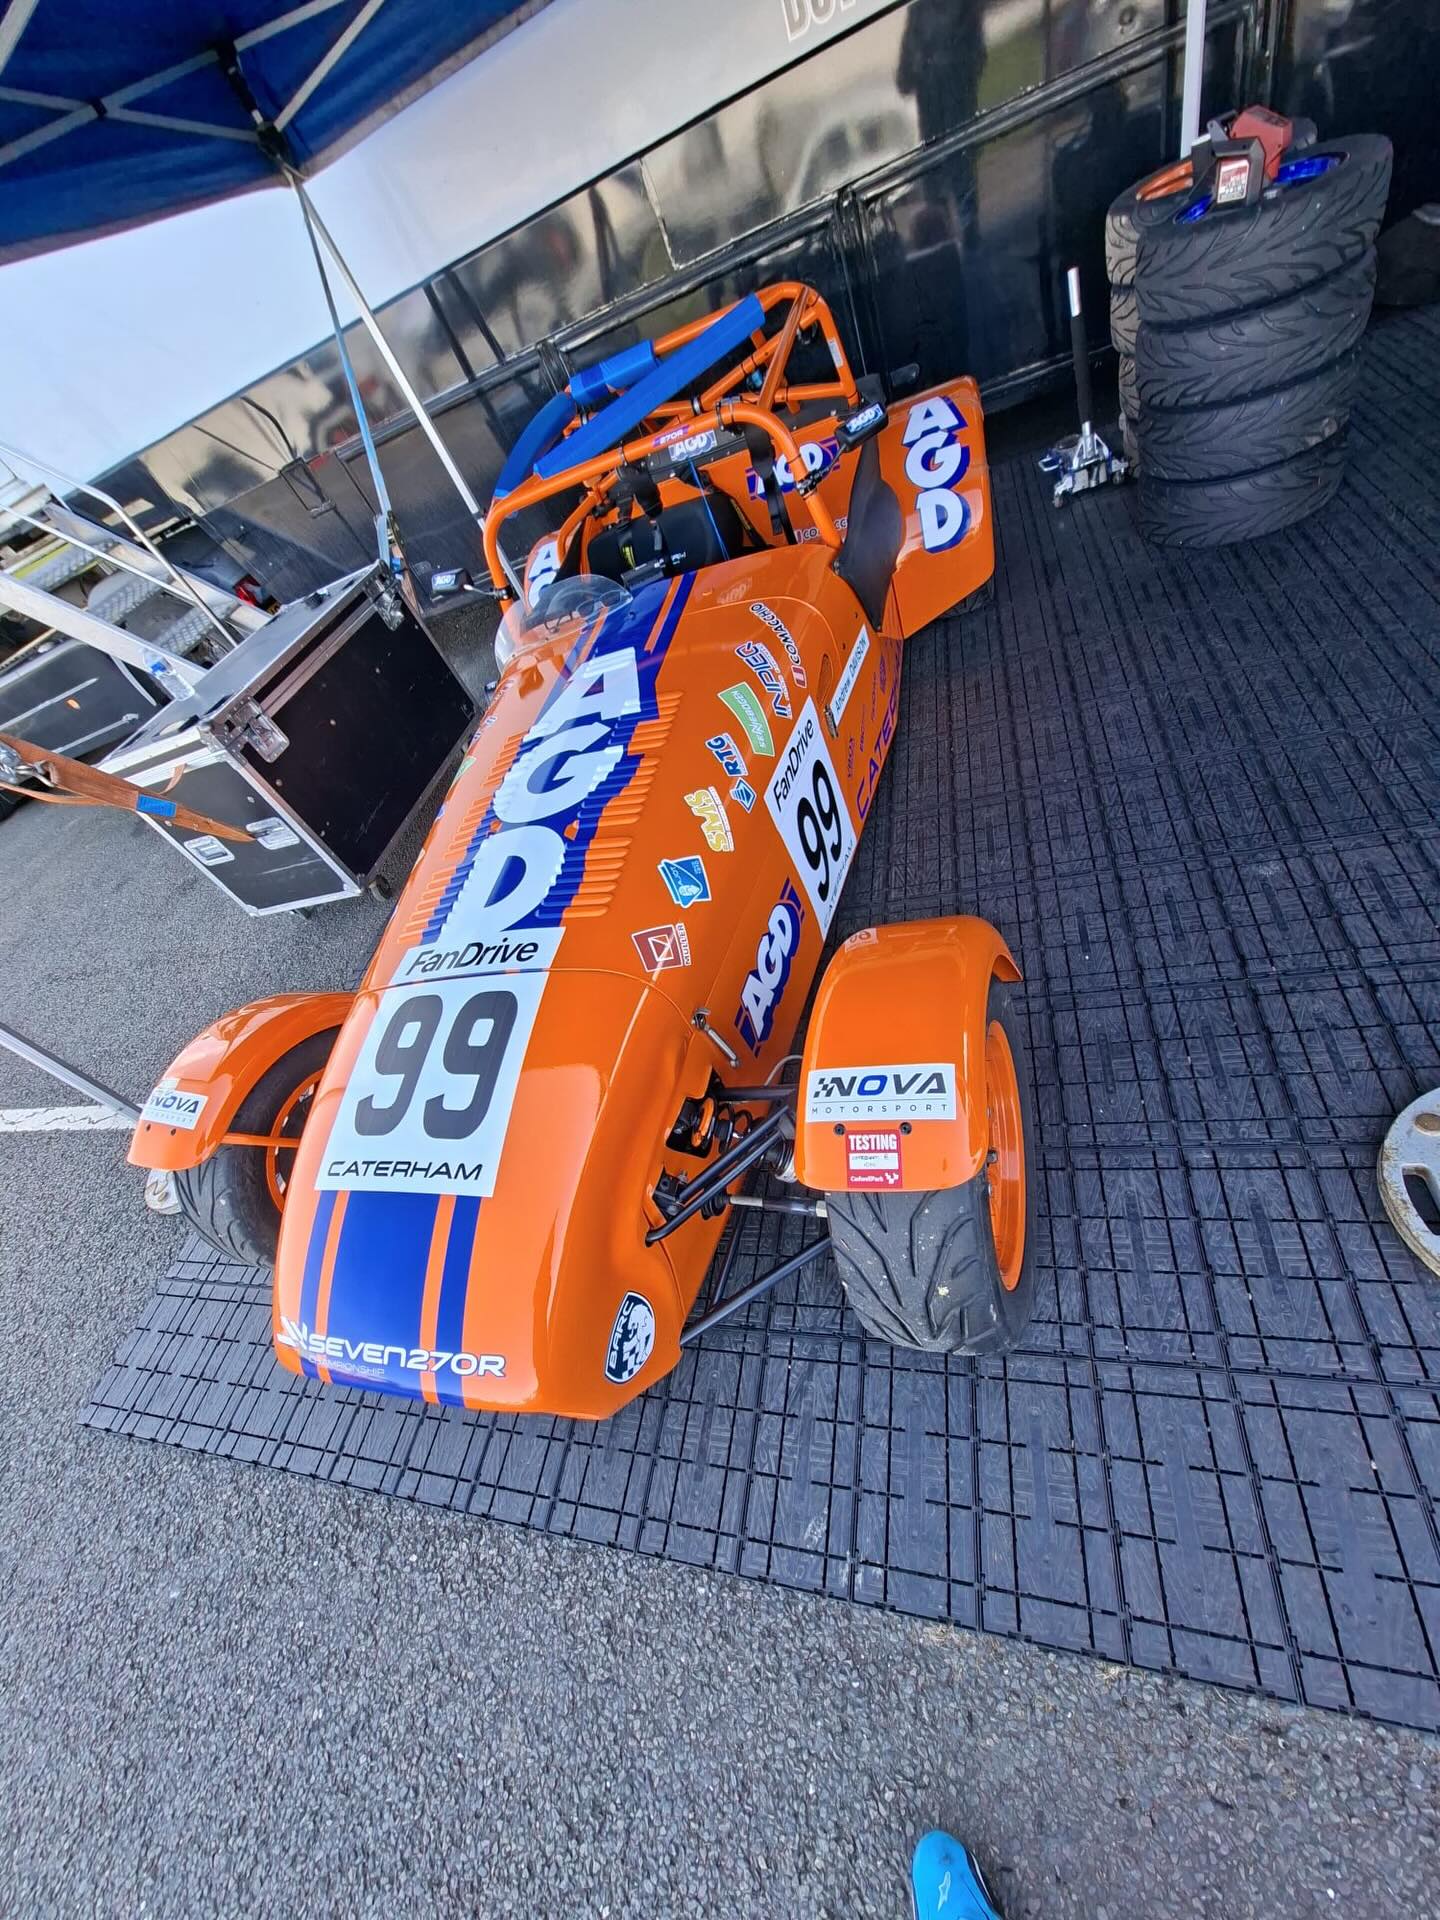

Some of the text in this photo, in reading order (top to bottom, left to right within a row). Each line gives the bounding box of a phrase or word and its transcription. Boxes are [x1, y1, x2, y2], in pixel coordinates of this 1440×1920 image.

[673, 433, 709, 457] AGD
[902, 396, 966, 552] AGD
[750, 603, 800, 665] COMACCHIO
[706, 736, 742, 775] RTG
[772, 718, 814, 813] FanDrive
[436, 646, 648, 940] AGD
[796, 759, 843, 903] 99
[405, 937, 540, 977] FanDrive
[741, 903, 797, 1041] AGD
[354, 989, 519, 1140] 99
[813, 1072, 948, 1099] NOVA
[811, 1103, 948, 1115] MOTORSPORT
[326, 1159, 484, 1181] CATERHAM
[848, 1134, 898, 1151] TESTING
[608, 1300, 635, 1370] BARC
